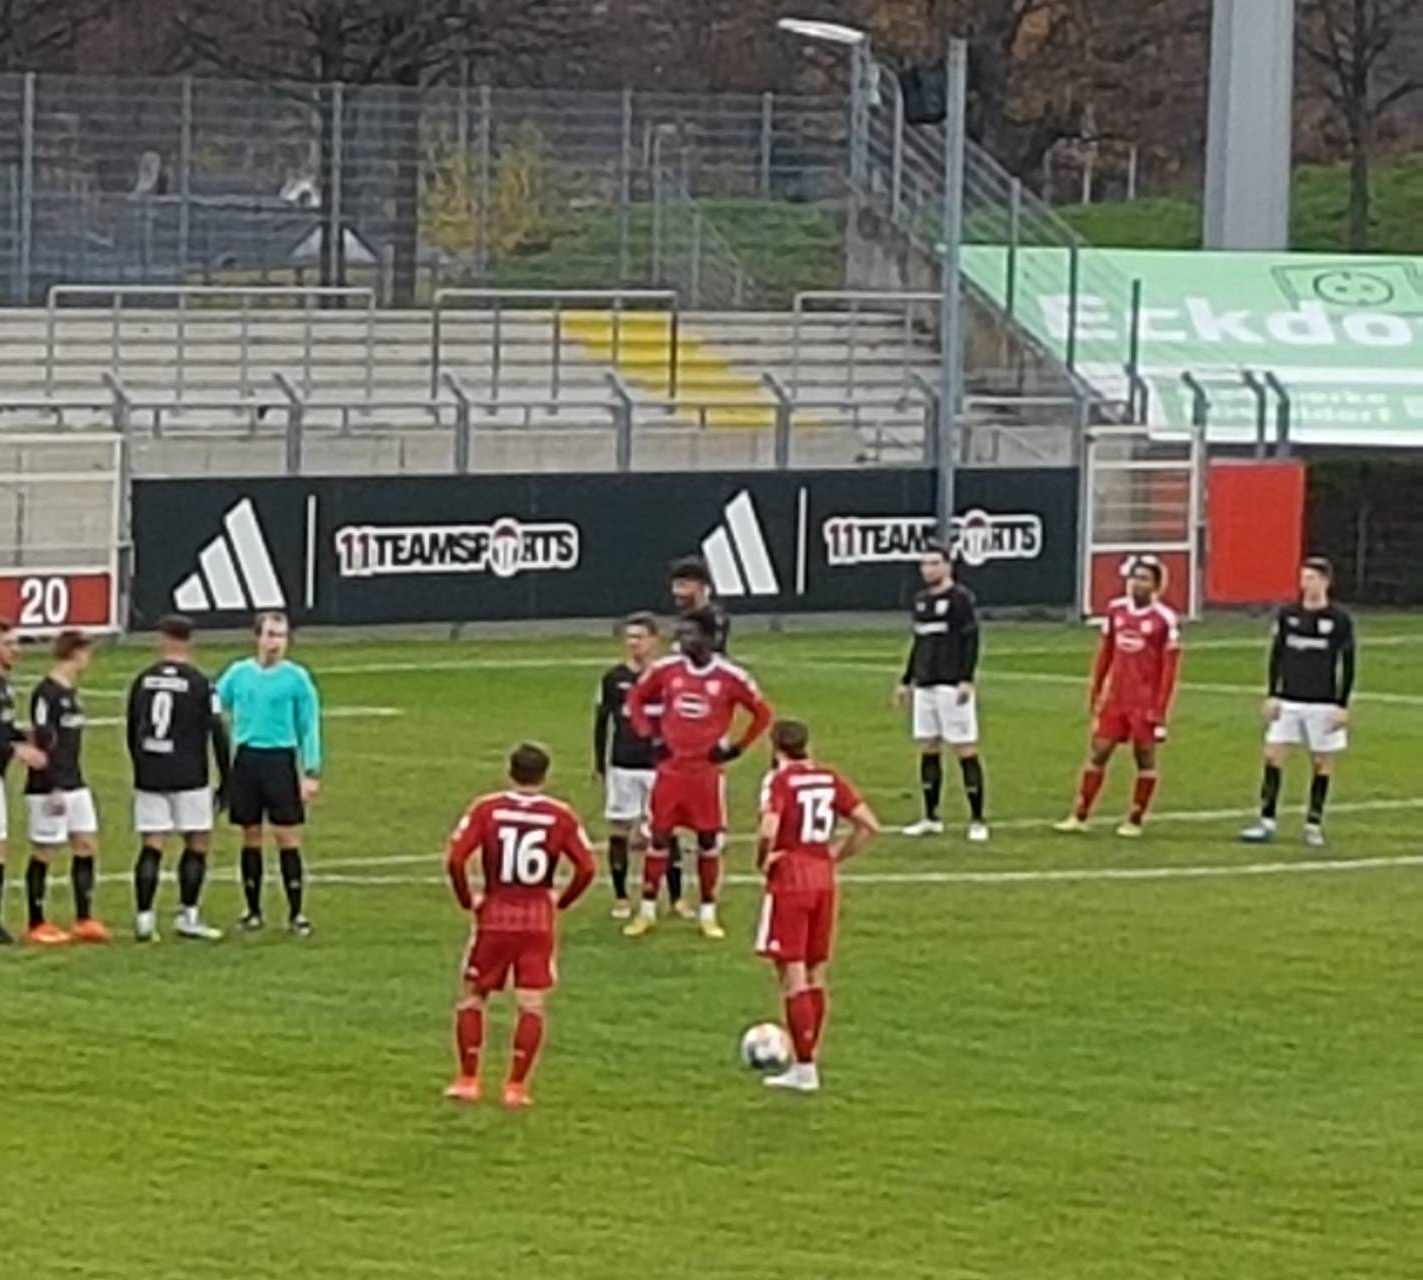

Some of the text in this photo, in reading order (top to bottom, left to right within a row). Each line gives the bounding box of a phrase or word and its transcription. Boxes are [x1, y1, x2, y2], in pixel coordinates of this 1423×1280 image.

[1038, 293, 1413, 347] Eckdo
[20, 577, 69, 624] 20
[151, 691, 173, 739] 9
[796, 787, 836, 843] 13
[497, 826, 549, 885] 16
